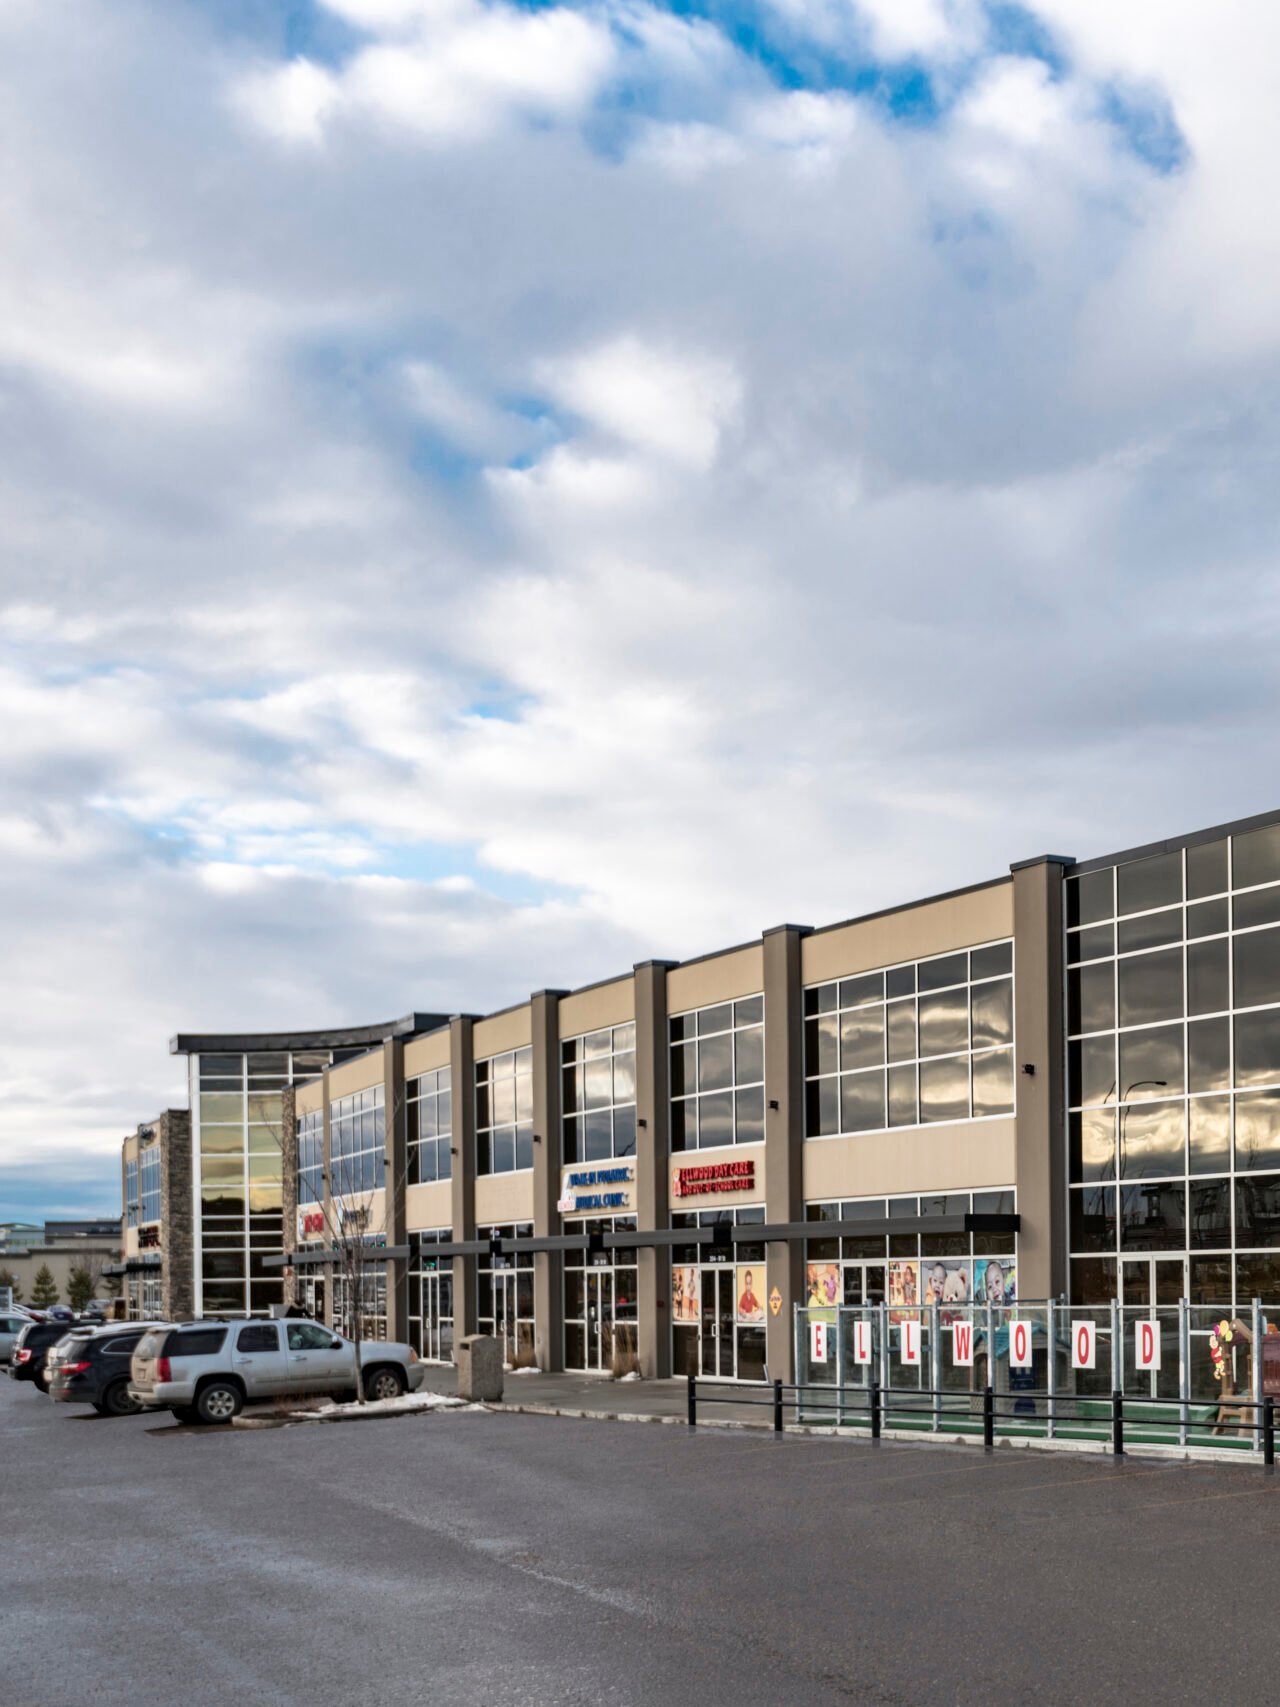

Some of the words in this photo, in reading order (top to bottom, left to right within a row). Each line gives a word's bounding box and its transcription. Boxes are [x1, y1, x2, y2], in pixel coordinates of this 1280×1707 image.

[681, 1165, 713, 1182] ELLWOOD
[714, 1163, 728, 1179] DAY
[729, 1161, 750, 1176] CARE
[734, 1178, 750, 1191] CARE
